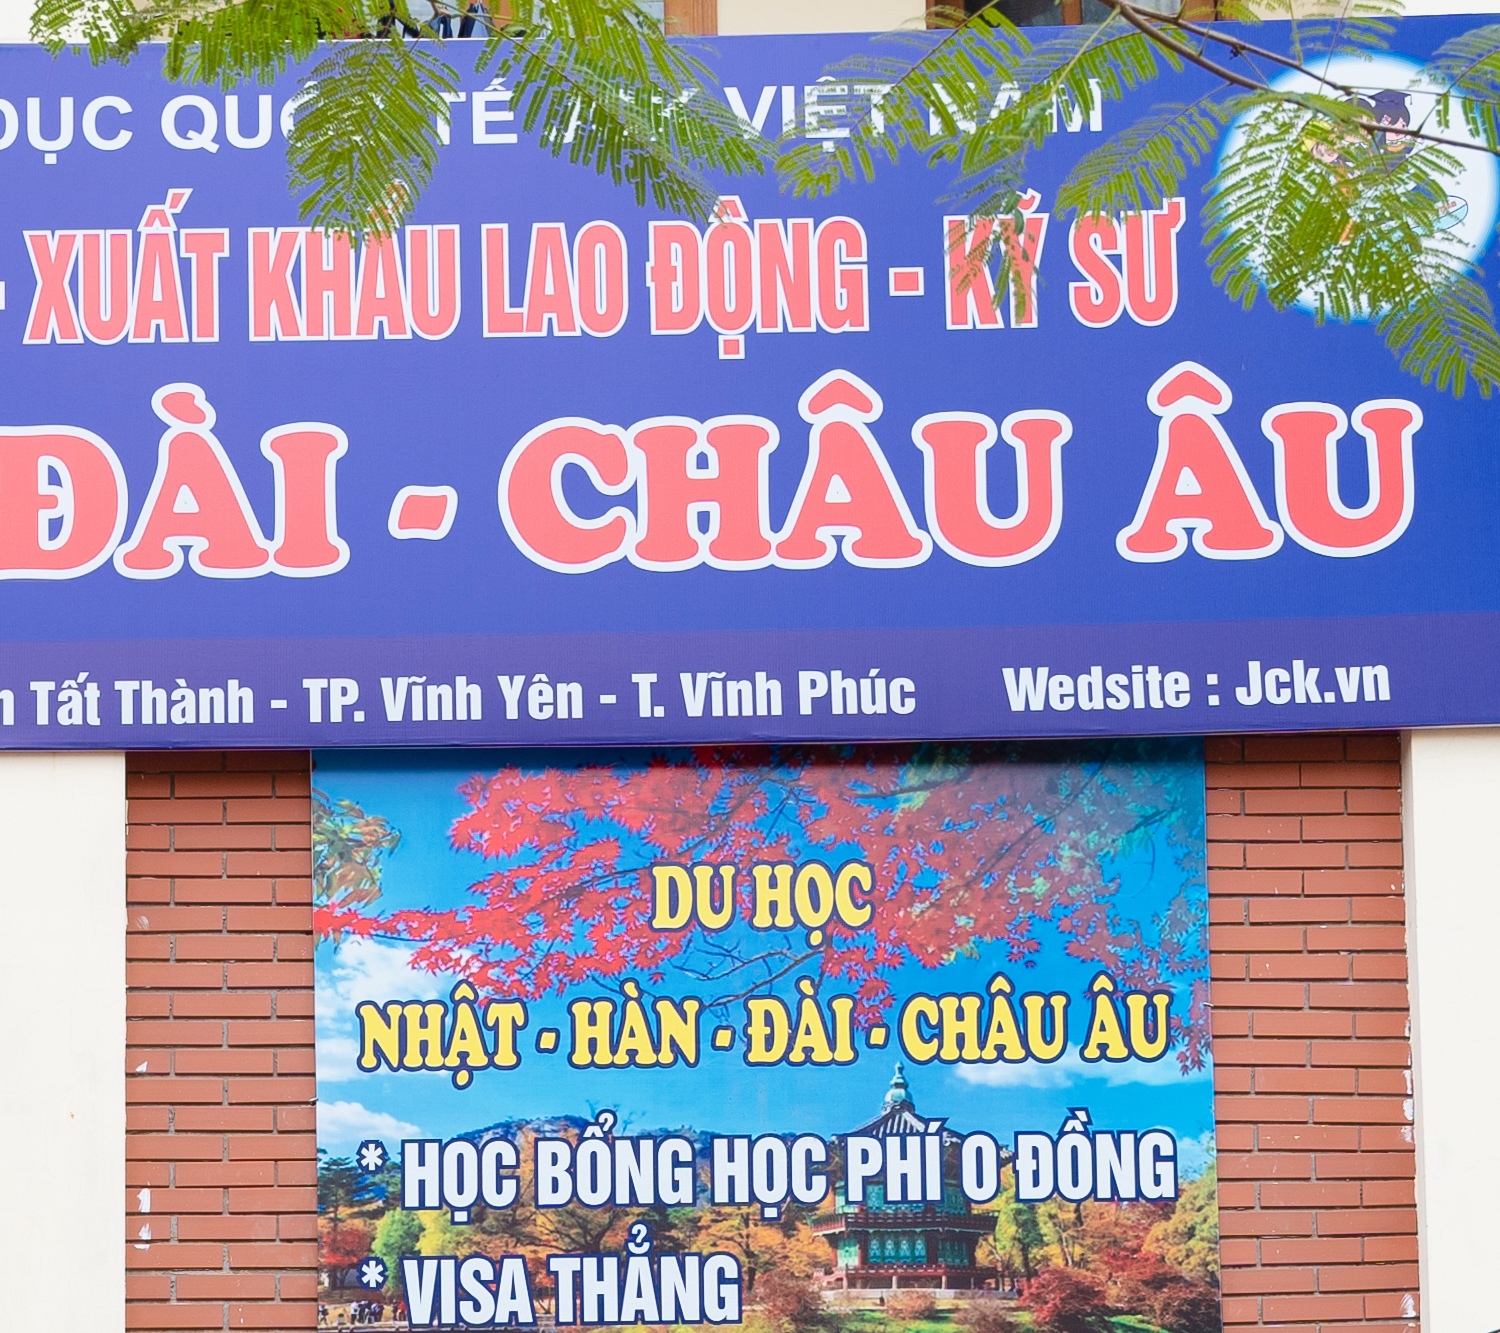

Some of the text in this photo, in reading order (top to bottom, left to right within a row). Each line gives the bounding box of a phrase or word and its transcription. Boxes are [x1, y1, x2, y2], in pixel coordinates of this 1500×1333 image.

[161, 80, 395, 152] QU
[22, 188, 230, 345] XUẤT
[248, 178, 461, 341] KHẨU
[481, 220, 629, 338] LAO
[649, 195, 868, 359] ĐỘNG
[1067, 199, 1185, 327] SƯ
[498, 368, 1073, 574] CHÂU
[1116, 361, 1423, 562] ÂU
[30, 672, 100, 725] Tất
[114, 679, 254, 724] Thành
[303, 678, 365, 722] TP.
[380, 676, 481, 721] Vĩnh
[497, 674, 583, 719] Yên
[632, 673, 664, 717] T.
[680, 672, 782, 716] Vĩnh
[799, 669, 915, 714] Phúc
[1002, 660, 1390, 711] Wedsite Jck.vn
[651, 861, 875, 946] DU HỌC
[356, 969, 1174, 1089] NHẬT HÀN ĐÀI CHÂU ÂU
[403, 1139, 520, 1225] HỌC
[537, 1109, 694, 1209] BỔNG
[712, 1133, 829, 1221] HỌC
[845, 1118, 943, 1206] PHÍ
[1015, 1107, 1178, 1202] ĐỒNG
[401, 1224, 743, 1328] VISA THẲNG
